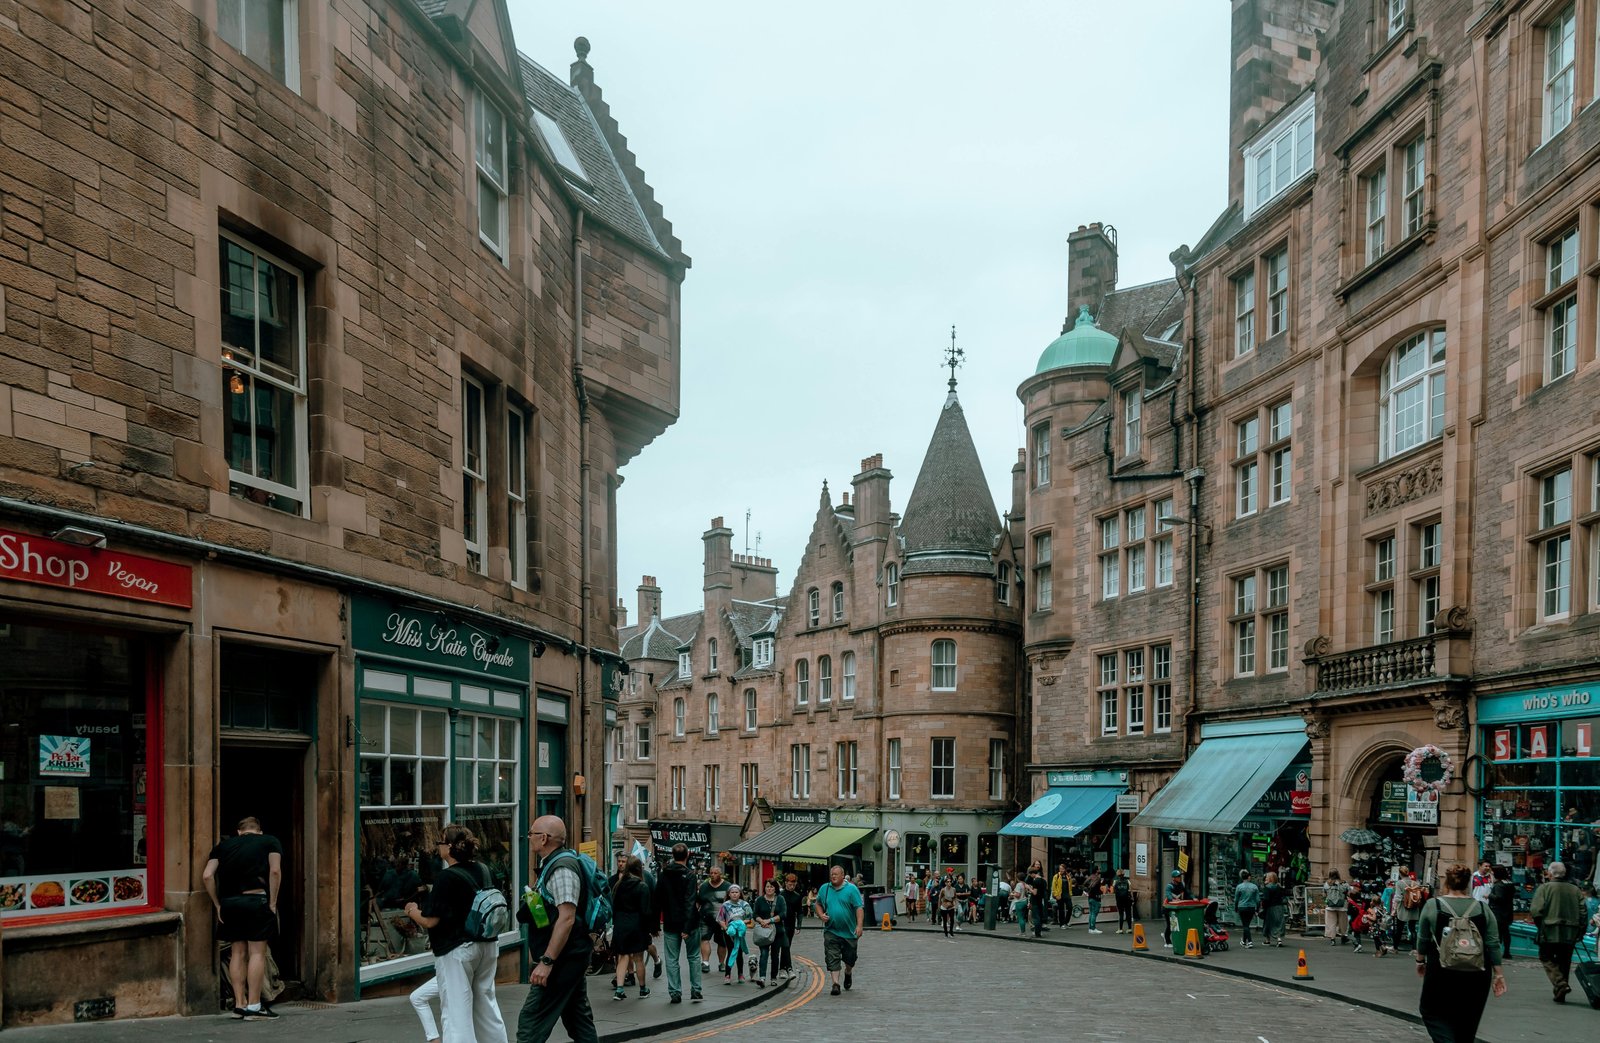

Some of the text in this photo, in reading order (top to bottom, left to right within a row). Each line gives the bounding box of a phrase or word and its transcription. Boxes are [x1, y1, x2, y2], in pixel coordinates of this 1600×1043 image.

[0, 534, 159, 594] Shop Vegan
[382, 612, 514, 671] Miss Katie Cupcake
[1523, 690, 1590, 710] who's who
[48, 760, 84, 769] KRUSH
[1260, 791, 1290, 801] SMAN
[784, 813, 790, 822] La
[792, 813, 814, 823] Locanda
[1242, 822, 1261, 830] GIFTS
[651, 830, 707, 842] WE SCOTLAND
[1137, 855, 1146, 864] 65
